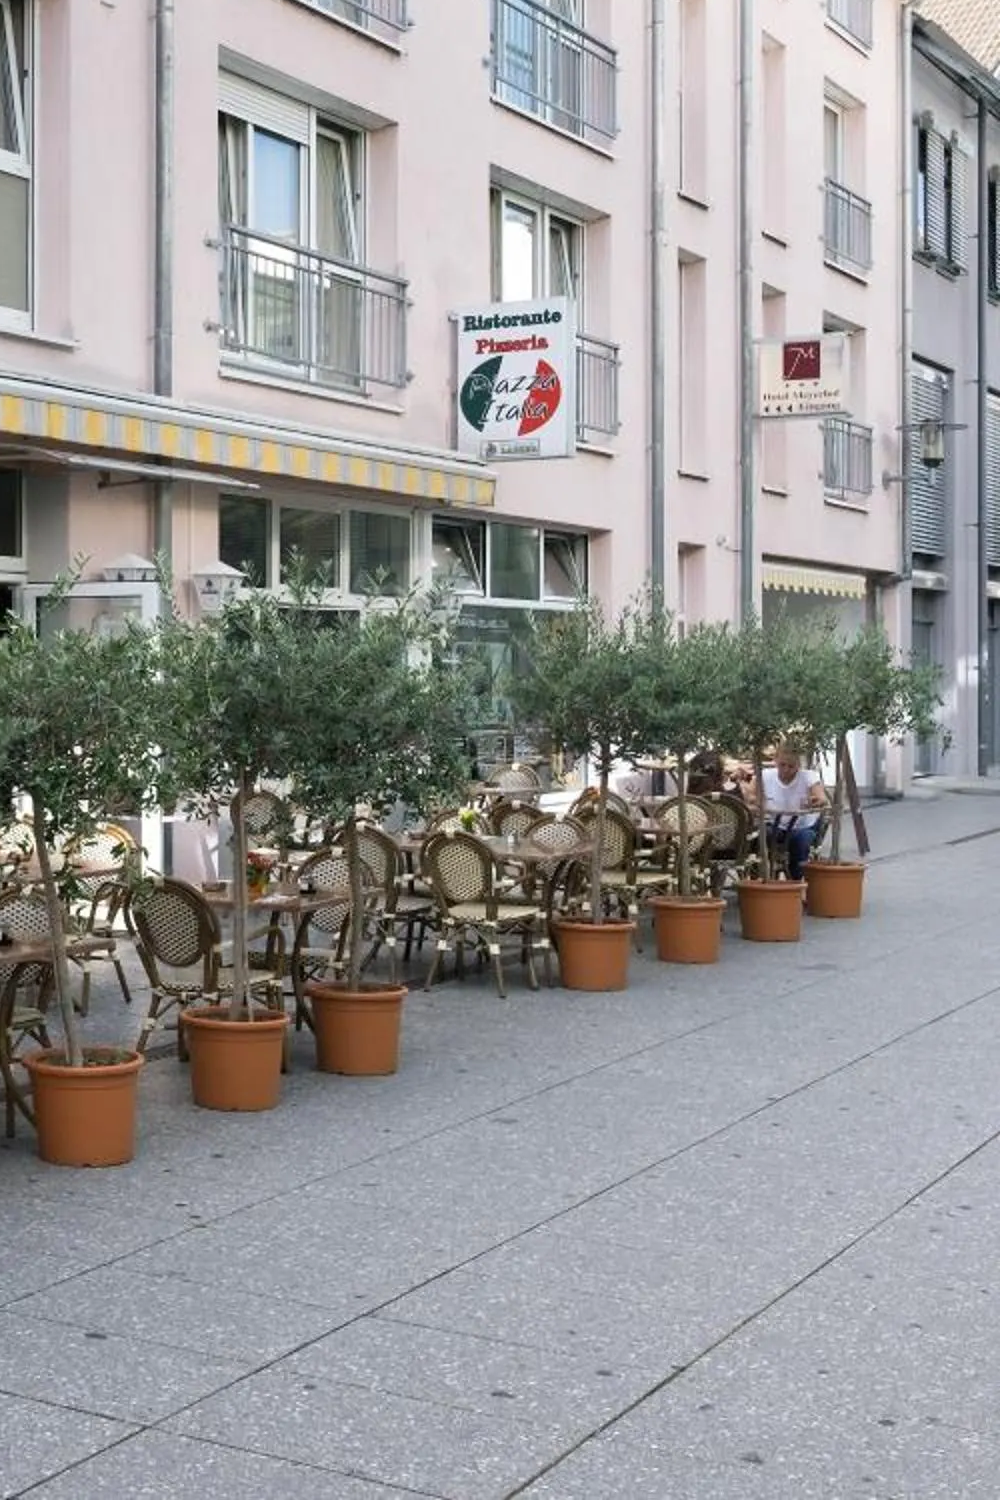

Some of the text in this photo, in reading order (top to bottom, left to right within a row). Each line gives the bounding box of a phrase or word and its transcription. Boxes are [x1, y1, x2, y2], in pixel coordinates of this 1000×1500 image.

[463, 308, 562, 332] Ristorante
[475, 334, 549, 355] Pizzeria
[478, 397, 549, 425] Italia
